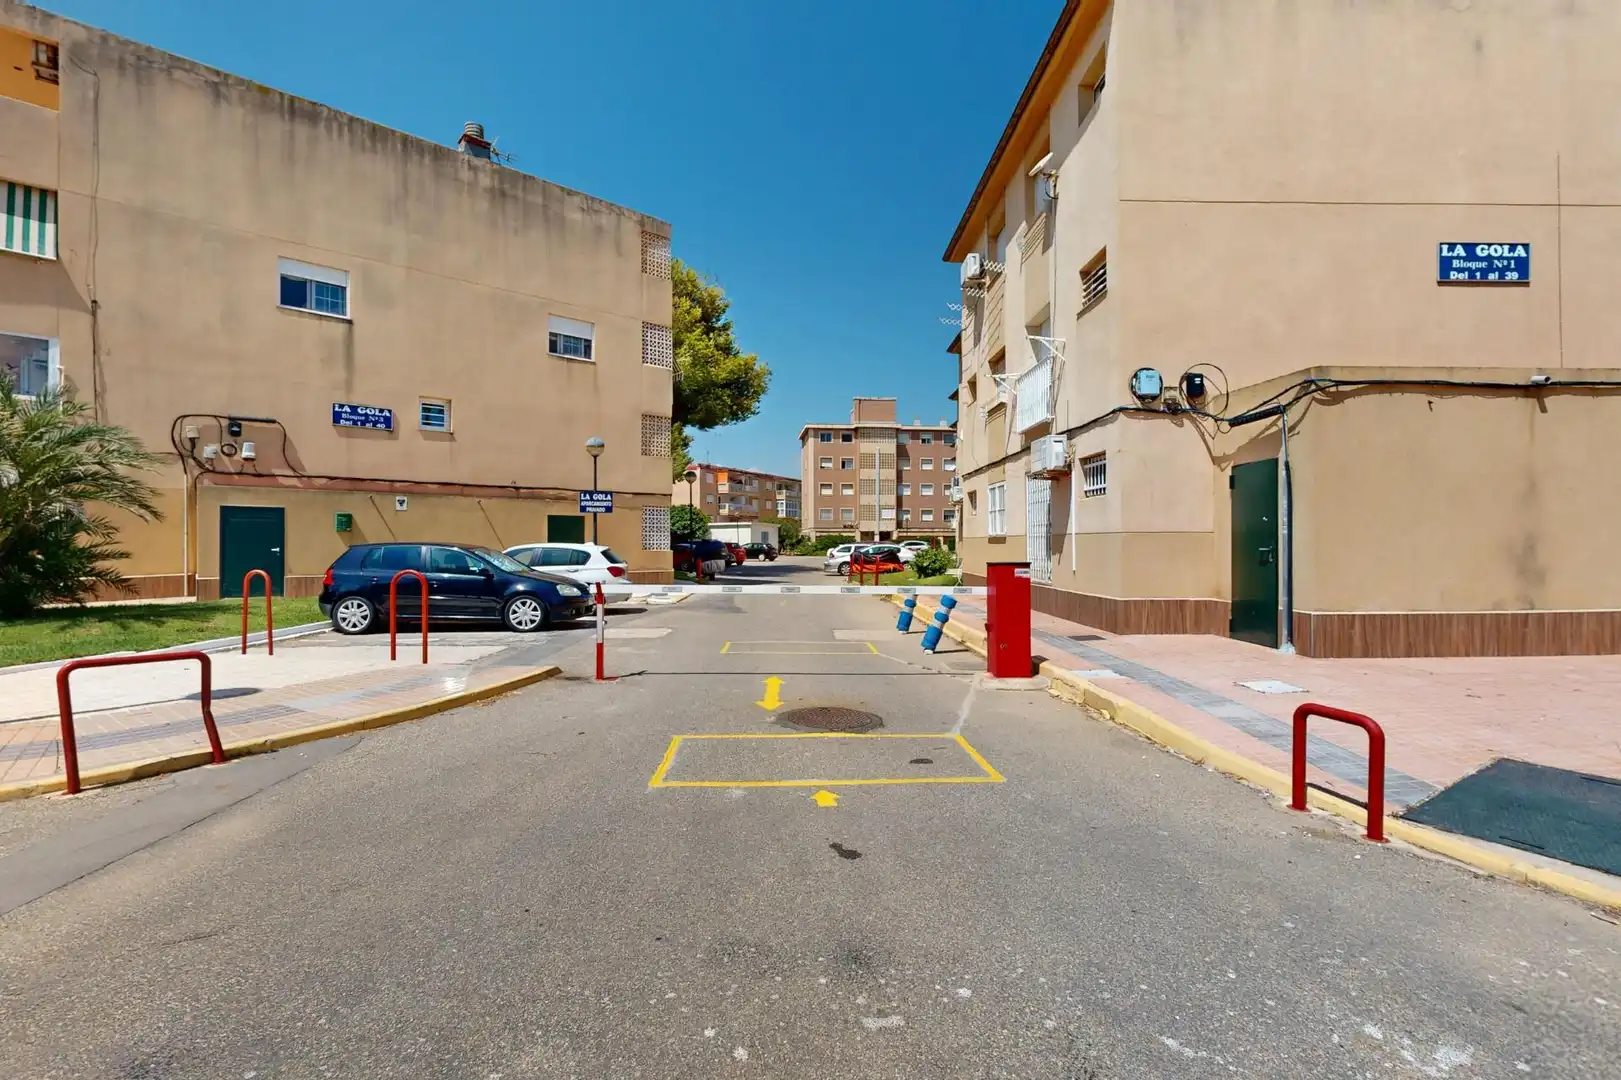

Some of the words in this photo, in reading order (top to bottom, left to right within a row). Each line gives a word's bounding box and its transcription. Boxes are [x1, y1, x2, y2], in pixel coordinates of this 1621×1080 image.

[1441, 244, 1467, 257] LA
[1475, 244, 1528, 257] GOLA
[1452, 259, 1488, 270] Bloque
[1450, 271, 1469, 280] Del
[1475, 271, 1481, 280] 1
[1488, 271, 1499, 280] al
[1505, 271, 1519, 281] 39
[334, 404, 351, 413] LA
[357, 406, 391, 417] GOLA
[341, 412, 366, 421] Bloque
[580, 493, 590, 501] LA
[592, 493, 612, 501] GOLA
